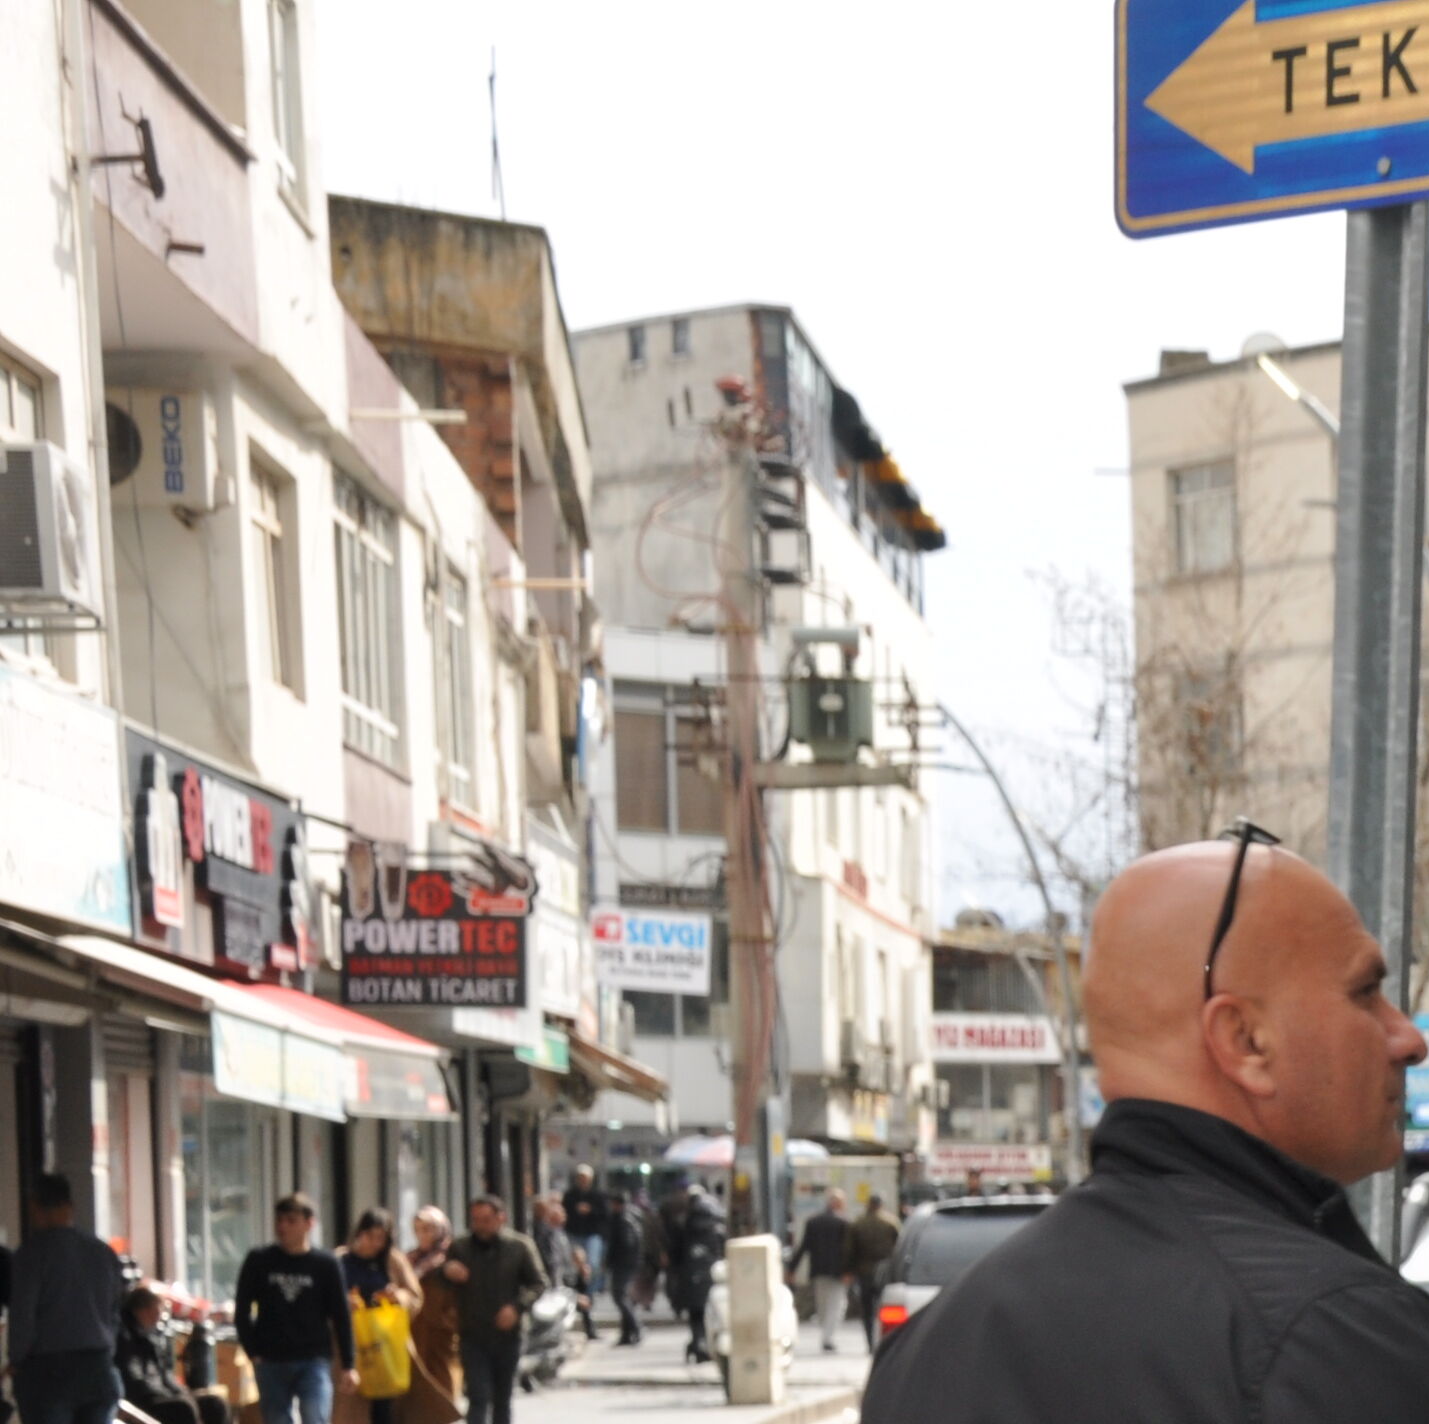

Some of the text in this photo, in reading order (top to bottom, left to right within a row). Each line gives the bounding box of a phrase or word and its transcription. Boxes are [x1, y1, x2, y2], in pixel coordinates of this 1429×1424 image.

[1271, 26, 1419, 115] TEK
[160, 395, 185, 494] BEKO
[343, 917, 518, 954] POWERTEC
[348, 973, 518, 1003] BOTAN TİCARET
